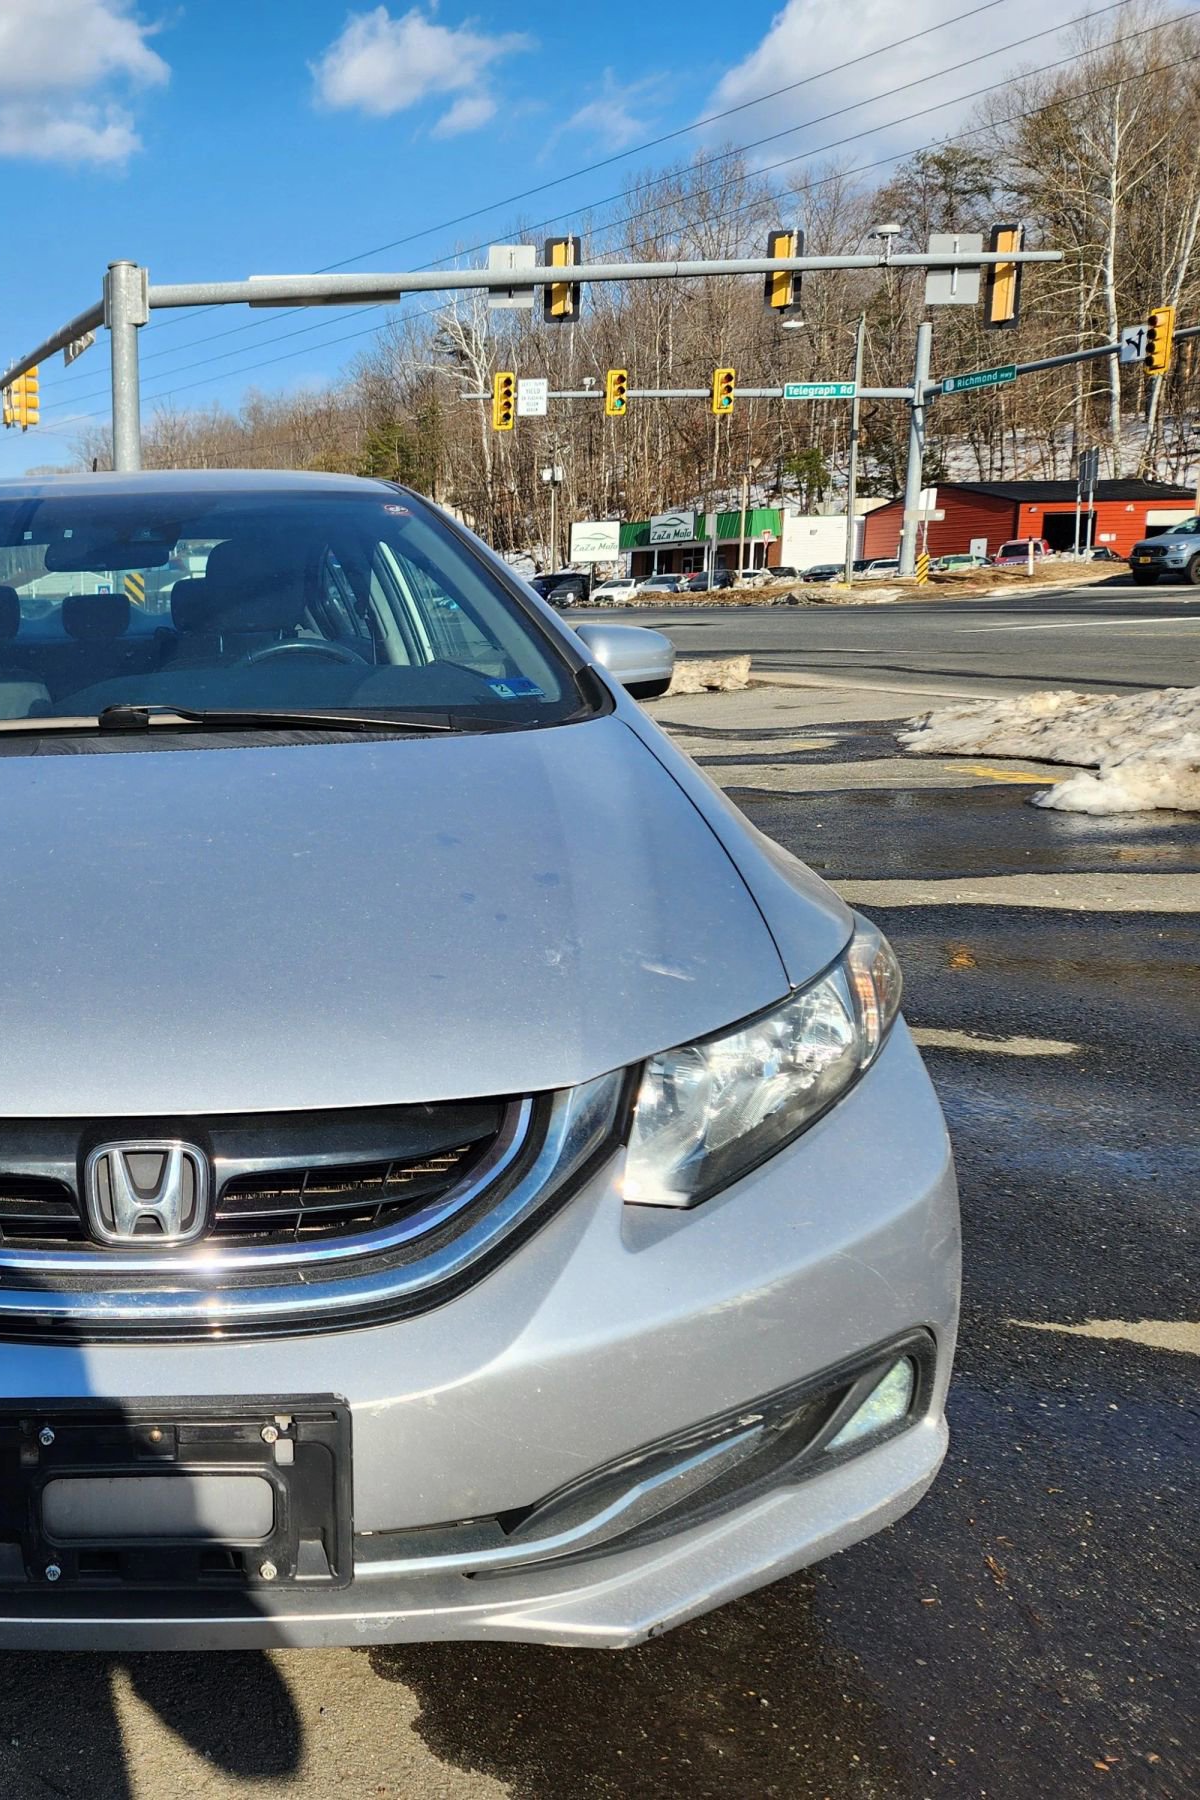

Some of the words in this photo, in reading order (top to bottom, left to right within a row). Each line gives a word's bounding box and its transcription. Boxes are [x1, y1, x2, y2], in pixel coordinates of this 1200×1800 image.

[957, 370, 998, 387] Richmond
[788, 385, 836, 397] Telegraph
[840, 385, 854, 395] Rd
[652, 530, 671, 541] ZaZa
[573, 543, 596, 552] ZaZa
